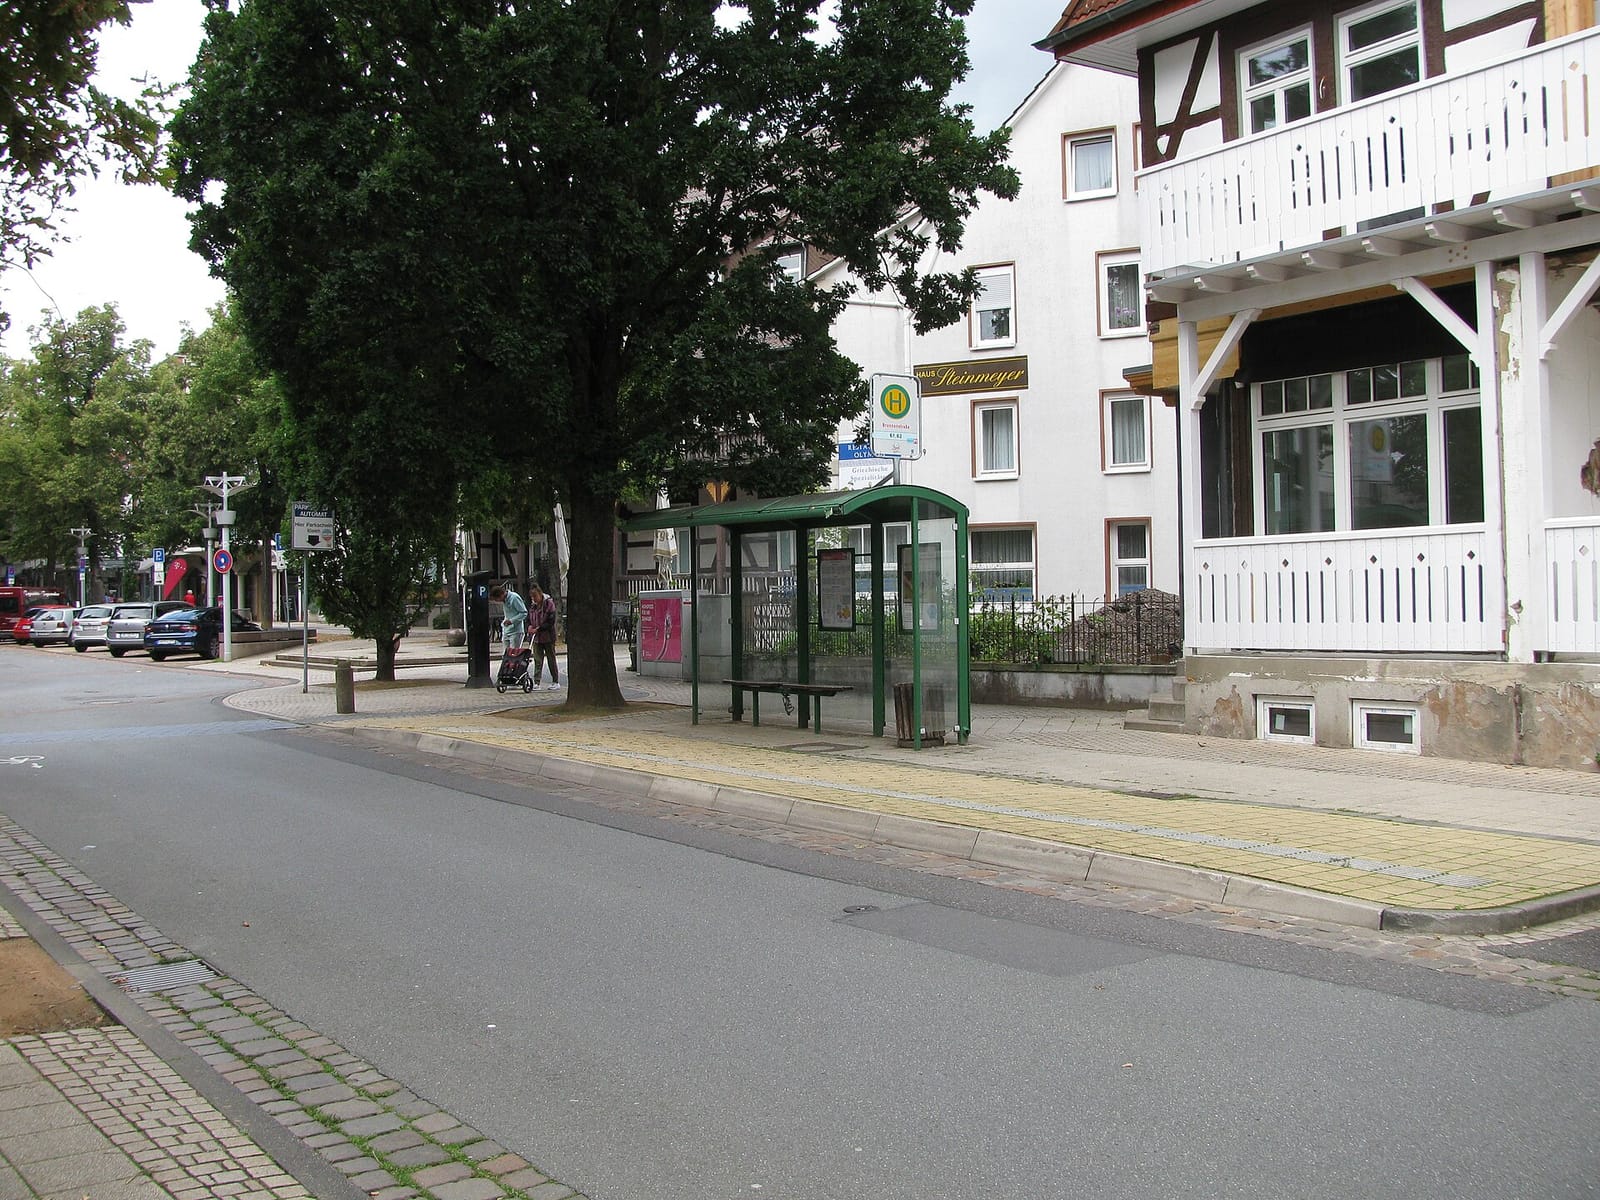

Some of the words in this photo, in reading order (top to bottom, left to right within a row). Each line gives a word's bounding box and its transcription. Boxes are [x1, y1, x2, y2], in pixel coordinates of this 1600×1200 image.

[916, 370, 936, 378] HAUS
[931, 367, 1025, 388] Steinmeyer
[889, 391, 902, 411] H
[479, 586, 486, 596] P
